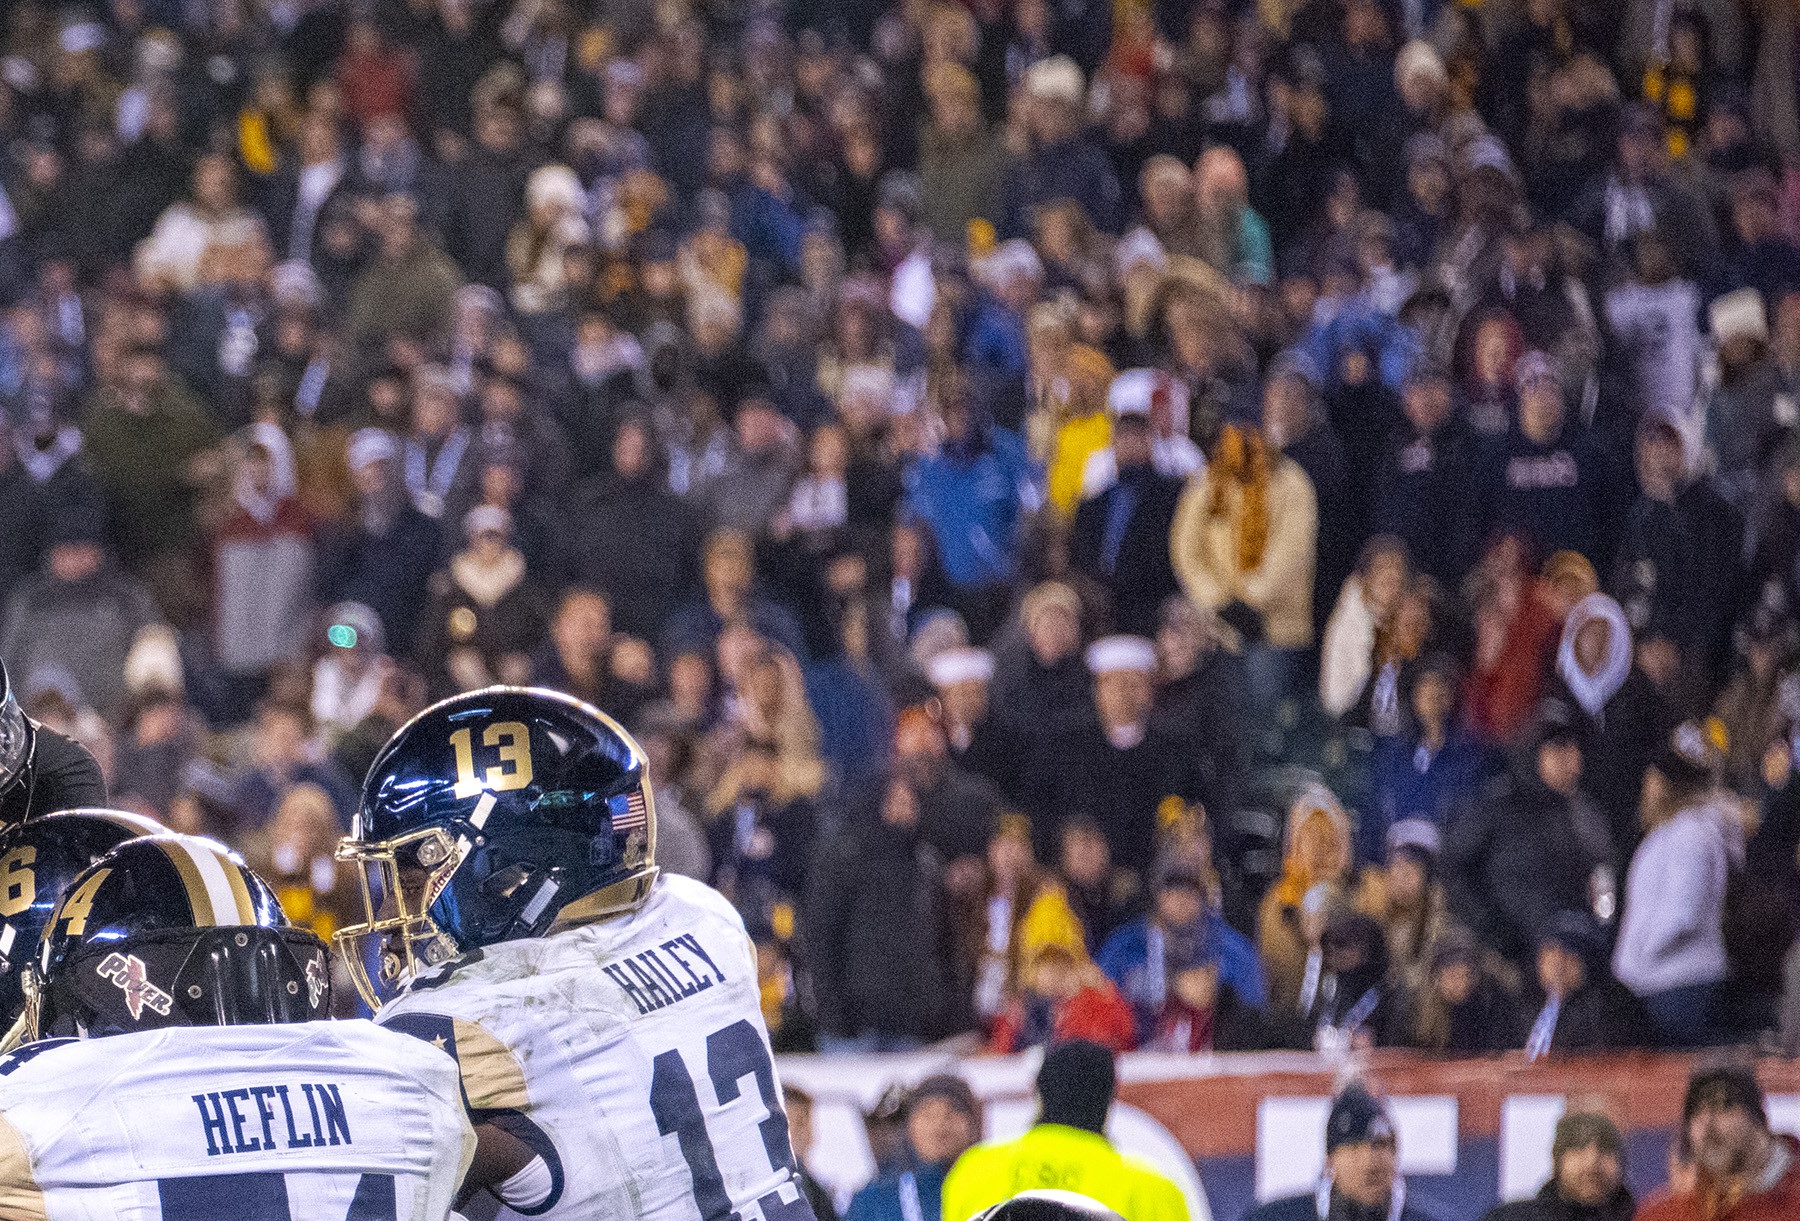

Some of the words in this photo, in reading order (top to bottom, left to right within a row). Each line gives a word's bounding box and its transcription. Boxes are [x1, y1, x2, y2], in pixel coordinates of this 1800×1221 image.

[450, 722, 533, 799] 13
[97, 952, 174, 1016] POWER
[603, 934, 726, 1015] HAILEY
[192, 1083, 352, 1156] HEFLIN
